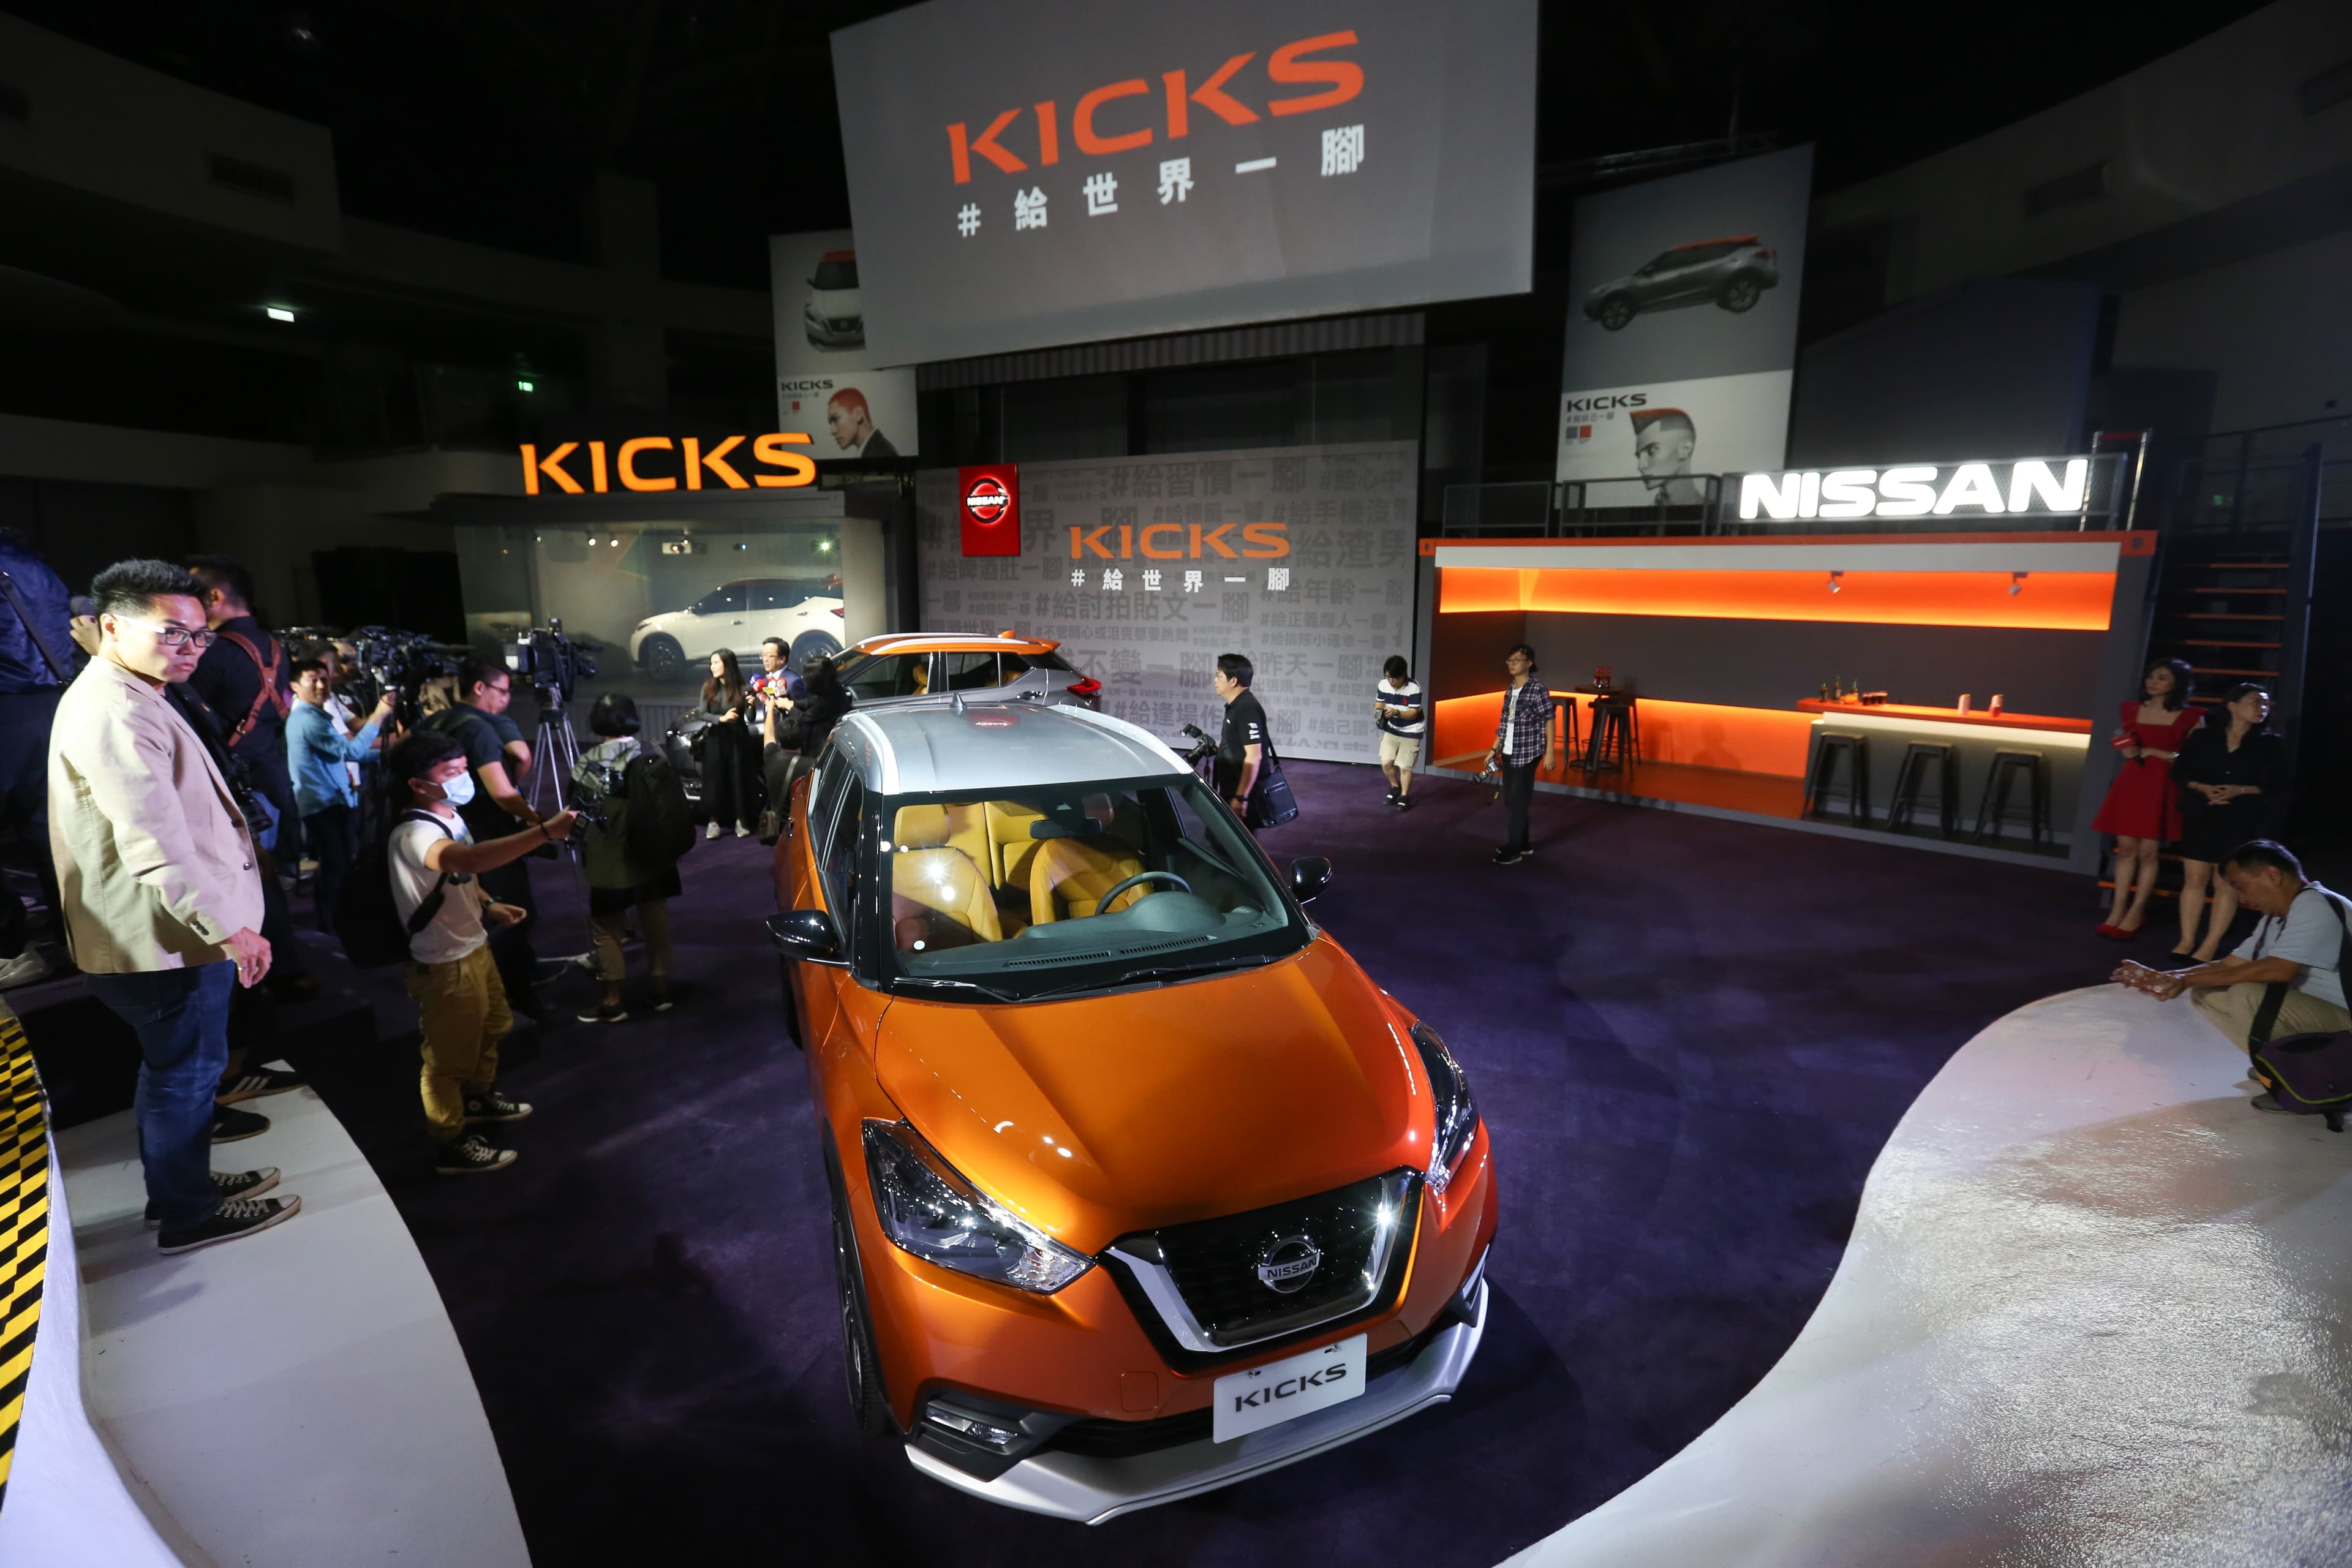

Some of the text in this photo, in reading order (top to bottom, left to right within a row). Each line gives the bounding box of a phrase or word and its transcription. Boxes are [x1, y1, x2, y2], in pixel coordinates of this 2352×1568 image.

[946, 30, 1365, 185] KICKS
[957, 124, 1365, 238] #給世界一腳
[781, 379, 834, 391] KICKS
[1567, 393, 1647, 412] KICKS
[519, 432, 816, 496] KICKS
[1740, 458, 2089, 519] NISSAN
[1069, 522, 1290, 559] KICKS
[1071, 568, 1289, 593] #給世界一腳
[1035, 590, 1250, 624] #給討拍貼文一腳
[1266, 1259, 1317, 1278] NISSAN
[1235, 1363, 1347, 1412] KICKS
